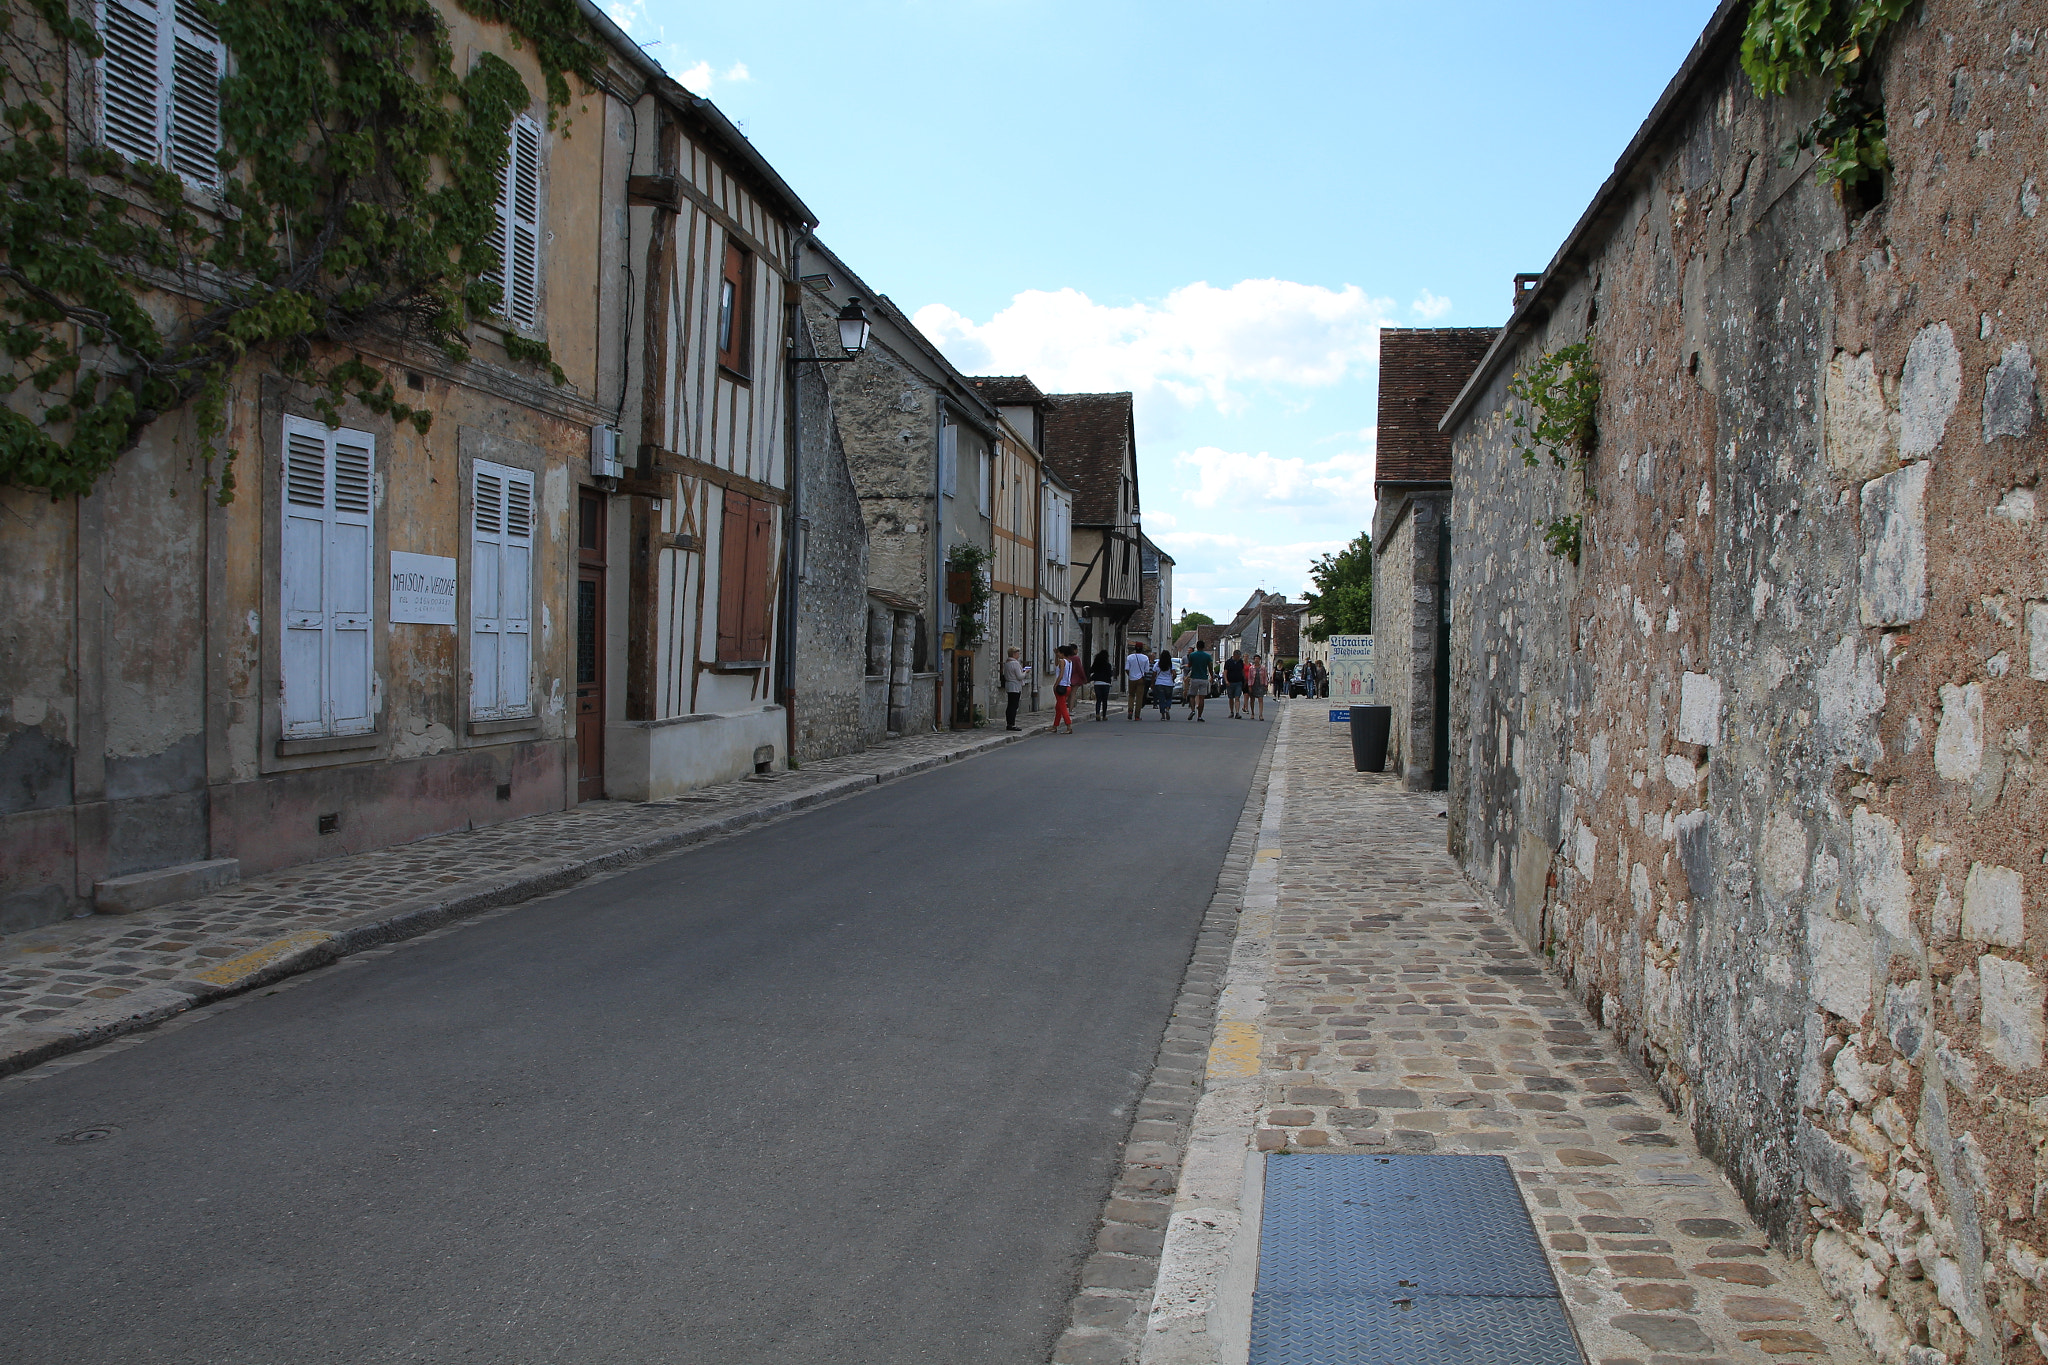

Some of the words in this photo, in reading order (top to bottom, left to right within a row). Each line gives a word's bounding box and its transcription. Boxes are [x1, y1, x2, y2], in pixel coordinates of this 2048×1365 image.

[392, 573, 424, 592] MAISON
[431, 576, 455, 596] VENDRE
[1331, 636, 1373, 646] Librairie
